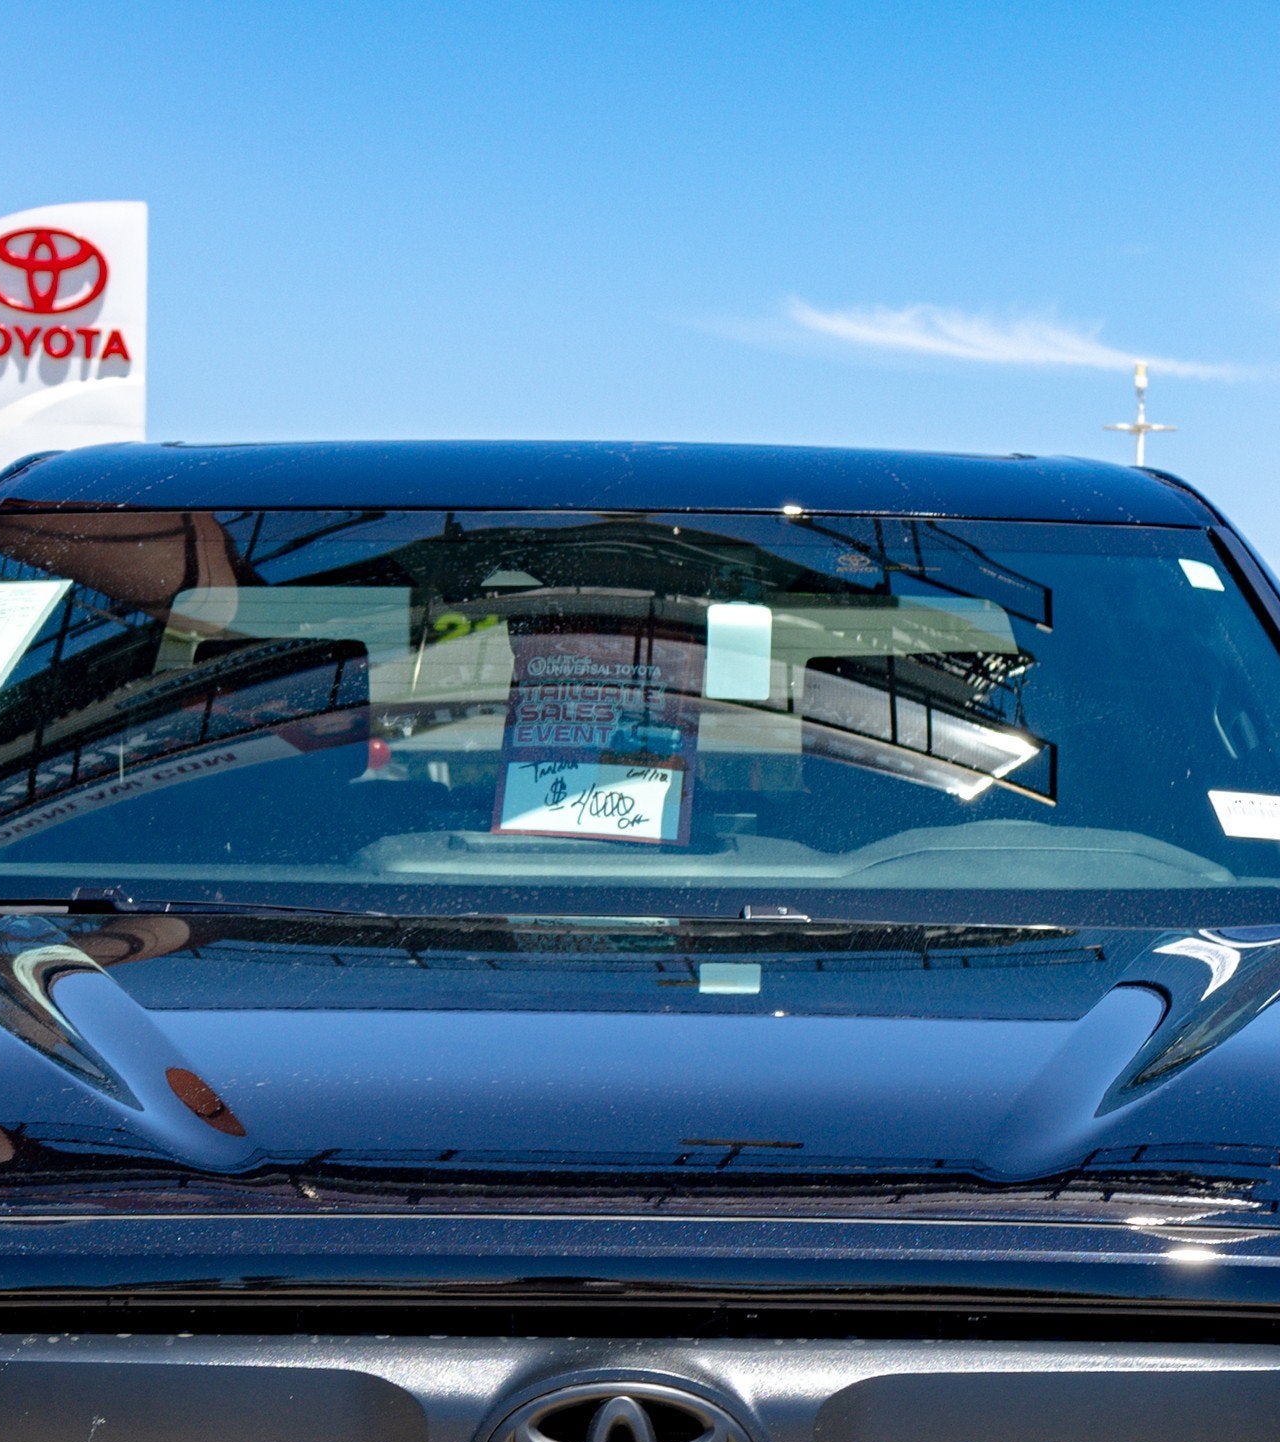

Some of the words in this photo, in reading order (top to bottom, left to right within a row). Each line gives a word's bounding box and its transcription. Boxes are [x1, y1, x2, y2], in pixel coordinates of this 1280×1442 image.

[546, 663, 612, 676] UNIVERSAL
[614, 665, 662, 677] TOYOTA
[521, 681, 664, 704] TAILGATE
[520, 703, 615, 723] SALES
[517, 725, 614, 744] EVENT
